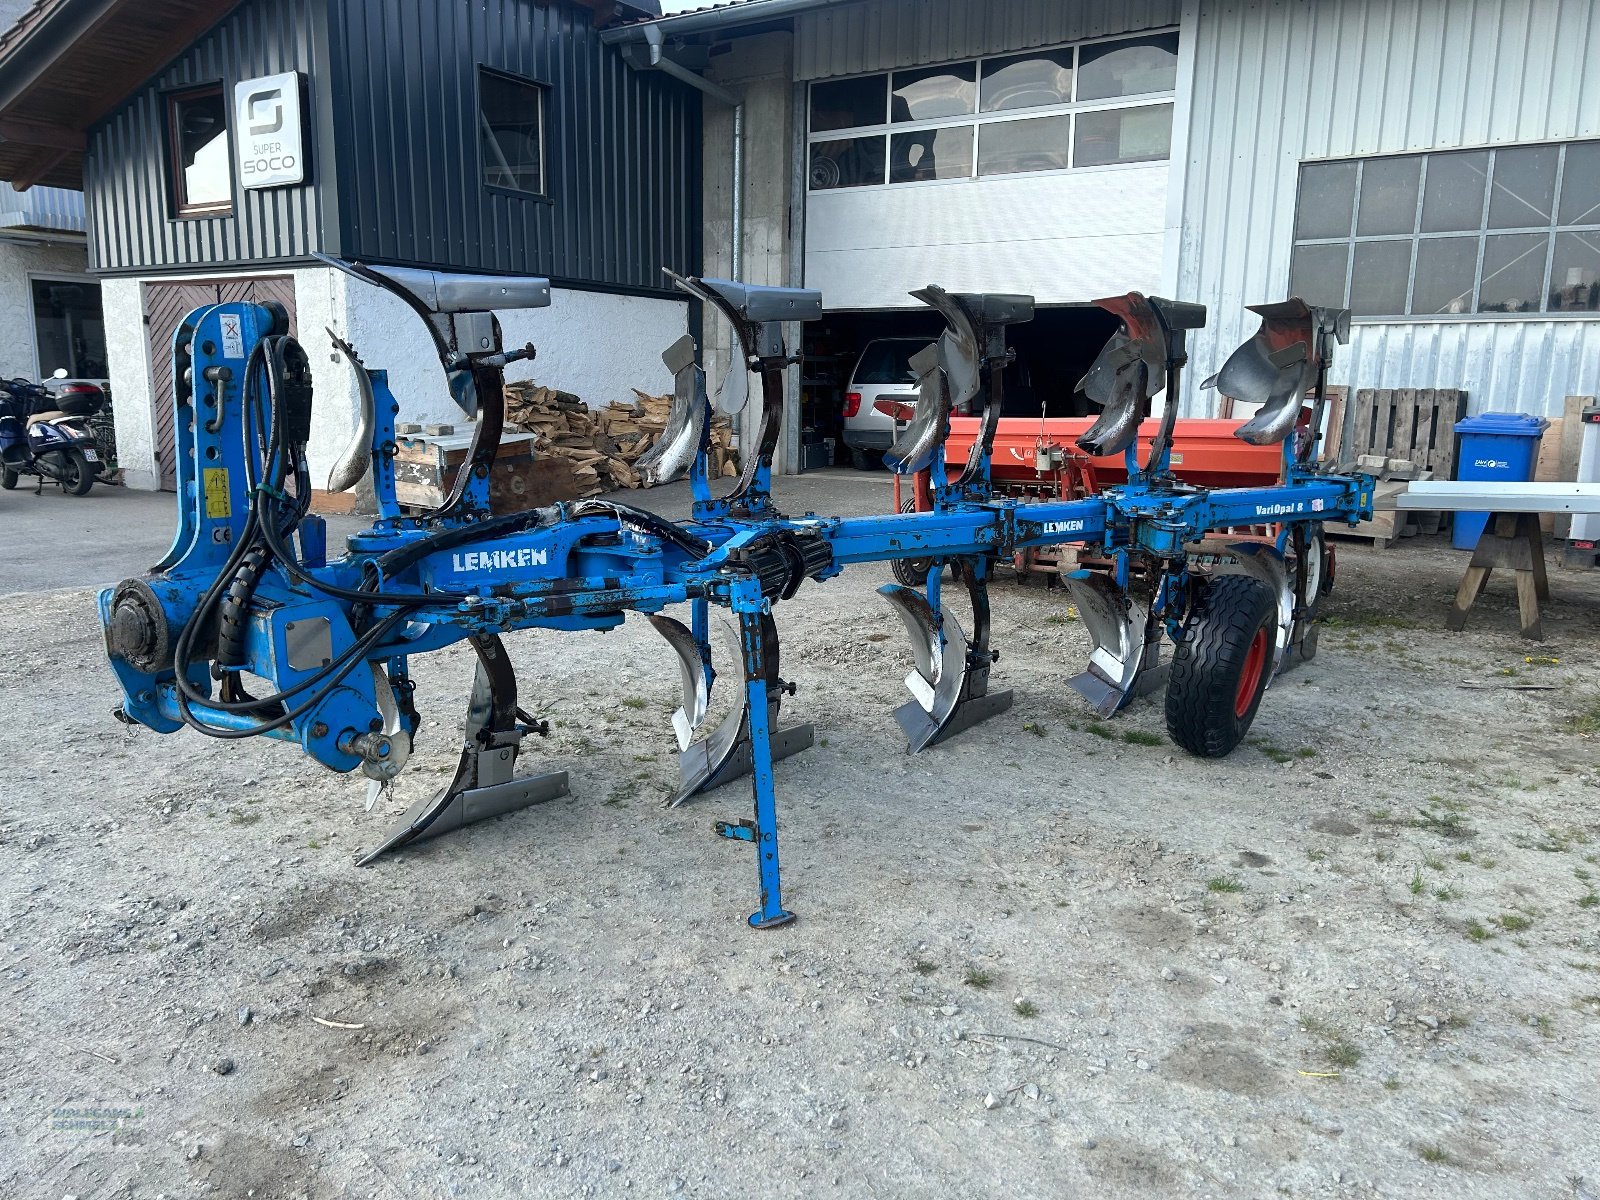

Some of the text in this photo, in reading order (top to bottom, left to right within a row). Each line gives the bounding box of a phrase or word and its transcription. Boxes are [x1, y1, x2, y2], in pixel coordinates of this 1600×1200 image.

[253, 142, 282, 155] SUPER
[243, 155, 295, 174] SOCO
[1255, 503, 1295, 515] VariOpal
[1297, 502, 1304, 512] 8
[1043, 519, 1084, 534] LEMKEN
[213, 528, 232, 543] CE
[452, 547, 548, 573] LEMKEN
